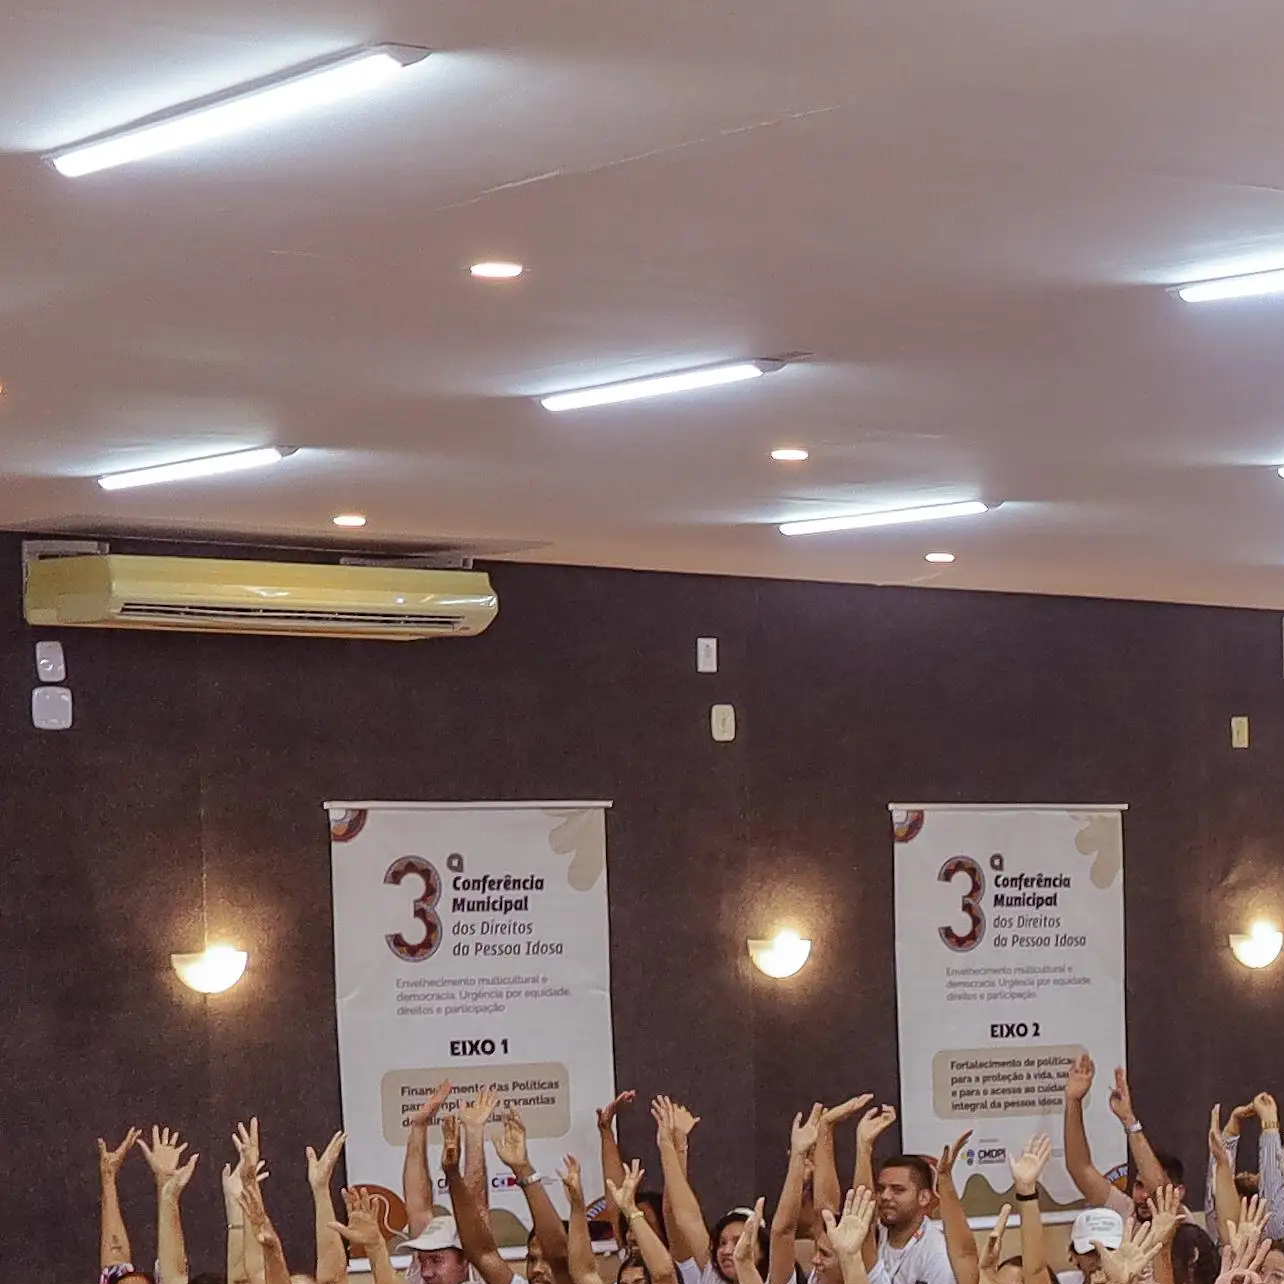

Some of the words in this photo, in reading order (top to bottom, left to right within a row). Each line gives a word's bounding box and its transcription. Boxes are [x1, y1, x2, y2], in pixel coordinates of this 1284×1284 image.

[452, 874, 544, 895] Conferência
[994, 873, 1071, 891] Conferência
[452, 895, 529, 913] Municipal
[993, 893, 1058, 910] Municipal
[452, 921, 476, 936] dos
[481, 920, 533, 936] Direitos
[993, 915, 1014, 929] dos
[1017, 915, 1061, 929] Direitos
[993, 935, 1008, 948] da
[1011, 934, 1051, 948] Pessoa
[1055, 934, 1087, 948] Idosa
[452, 942, 470, 956] da
[475, 941, 521, 957] Pessoa
[526, 941, 563, 957] Idosa
[506, 990, 523, 1000] por
[990, 1023, 1028, 1038] EIXO
[1032, 1022, 1041, 1036] 2
[450, 1039, 495, 1057] EIXO
[501, 1039, 509, 1054] 1
[950, 1059, 1022, 1070] Fortalecimento
[1023, 1058, 1036, 1066] de
[512, 1080, 559, 1091] Políticas
[951, 1076, 972, 1086] para
[982, 1072, 1024, 1083] proteção
[959, 1089, 981, 1099] para
[951, 1101, 988, 1112] integral
[990, 1100, 1001, 1108] da
[1004, 1100, 1036, 1110] pessoa
